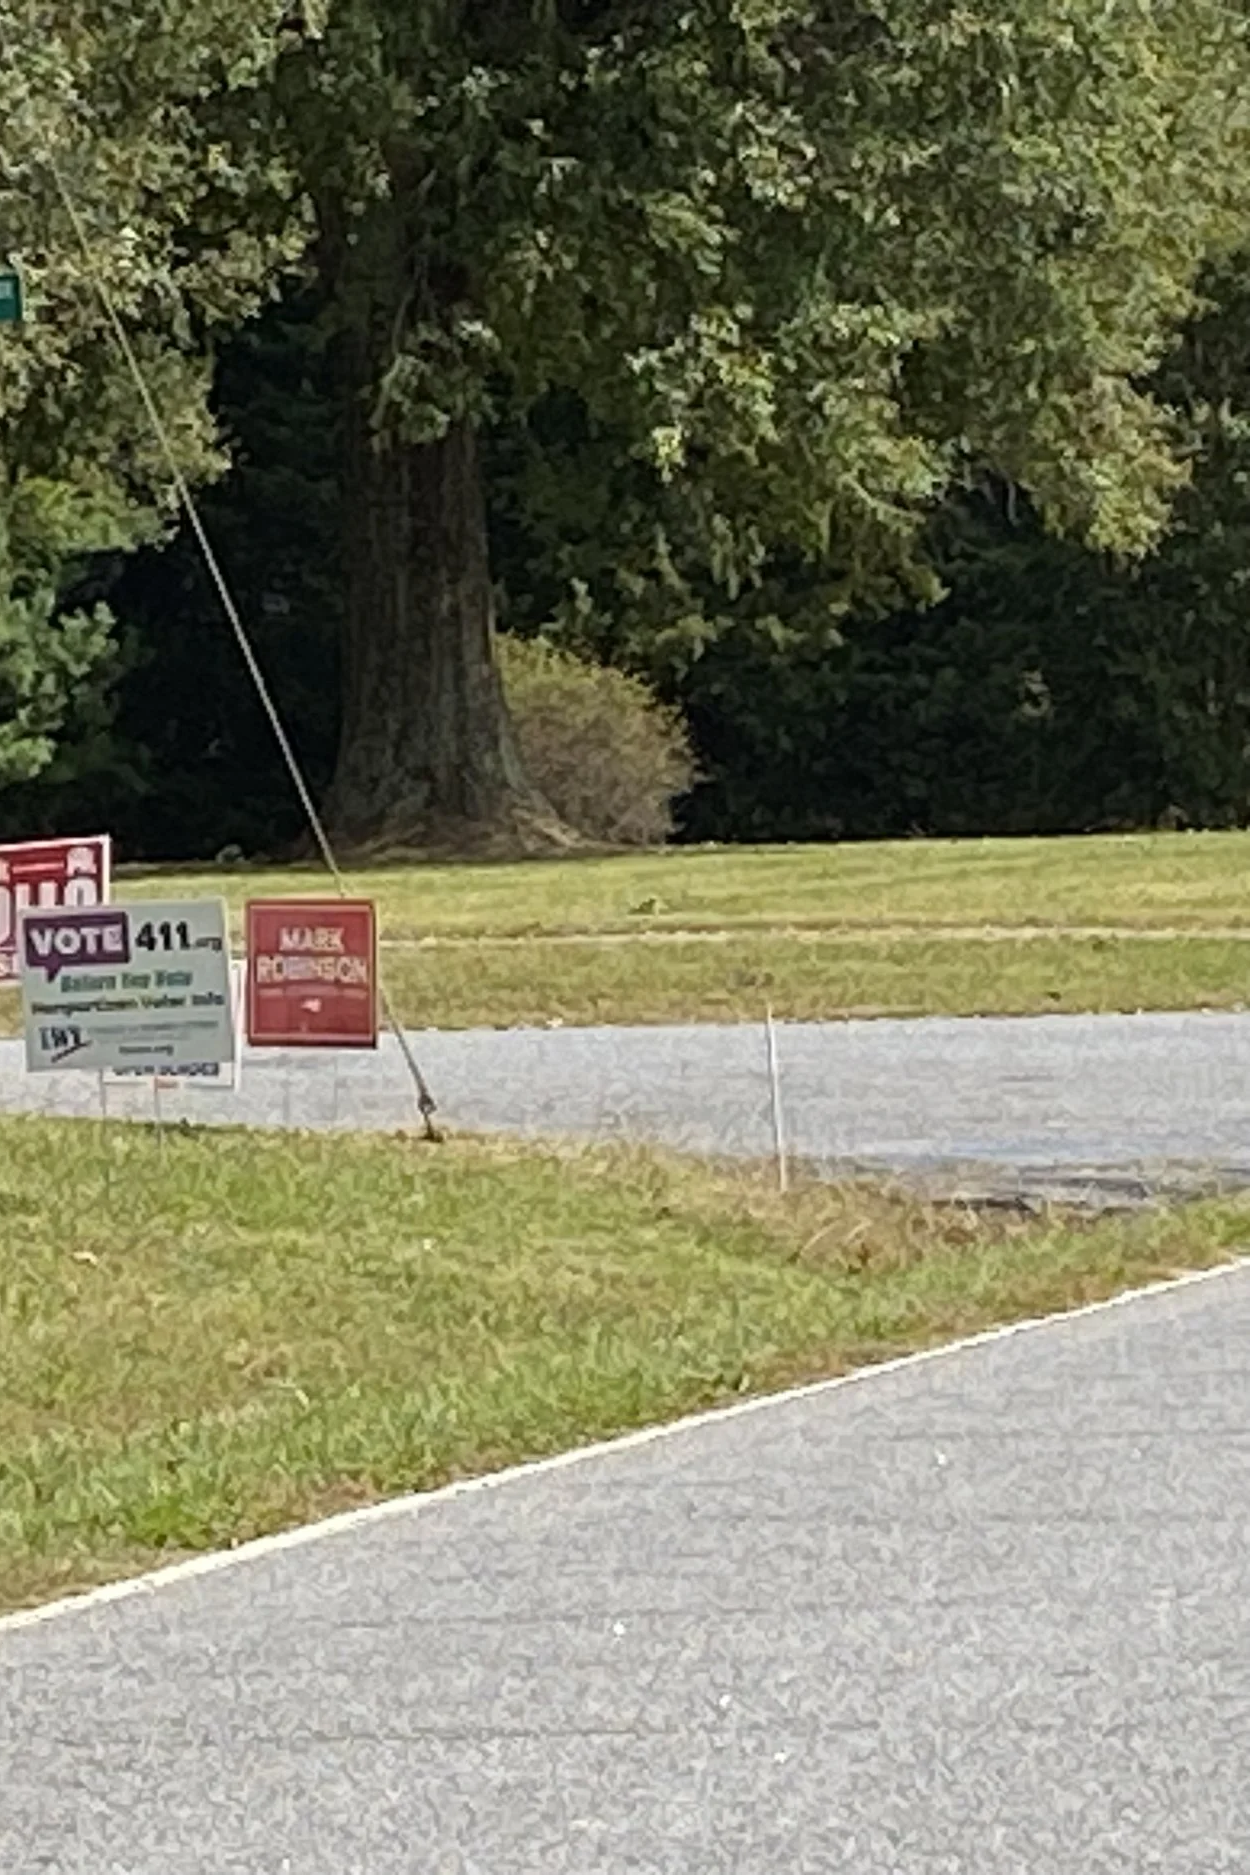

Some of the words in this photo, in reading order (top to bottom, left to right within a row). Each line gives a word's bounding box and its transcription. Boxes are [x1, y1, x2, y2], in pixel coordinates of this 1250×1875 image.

[29, 924, 123, 956] VOTE
[280, 927, 345, 953] MARK
[257, 953, 367, 983] ROBINSON
